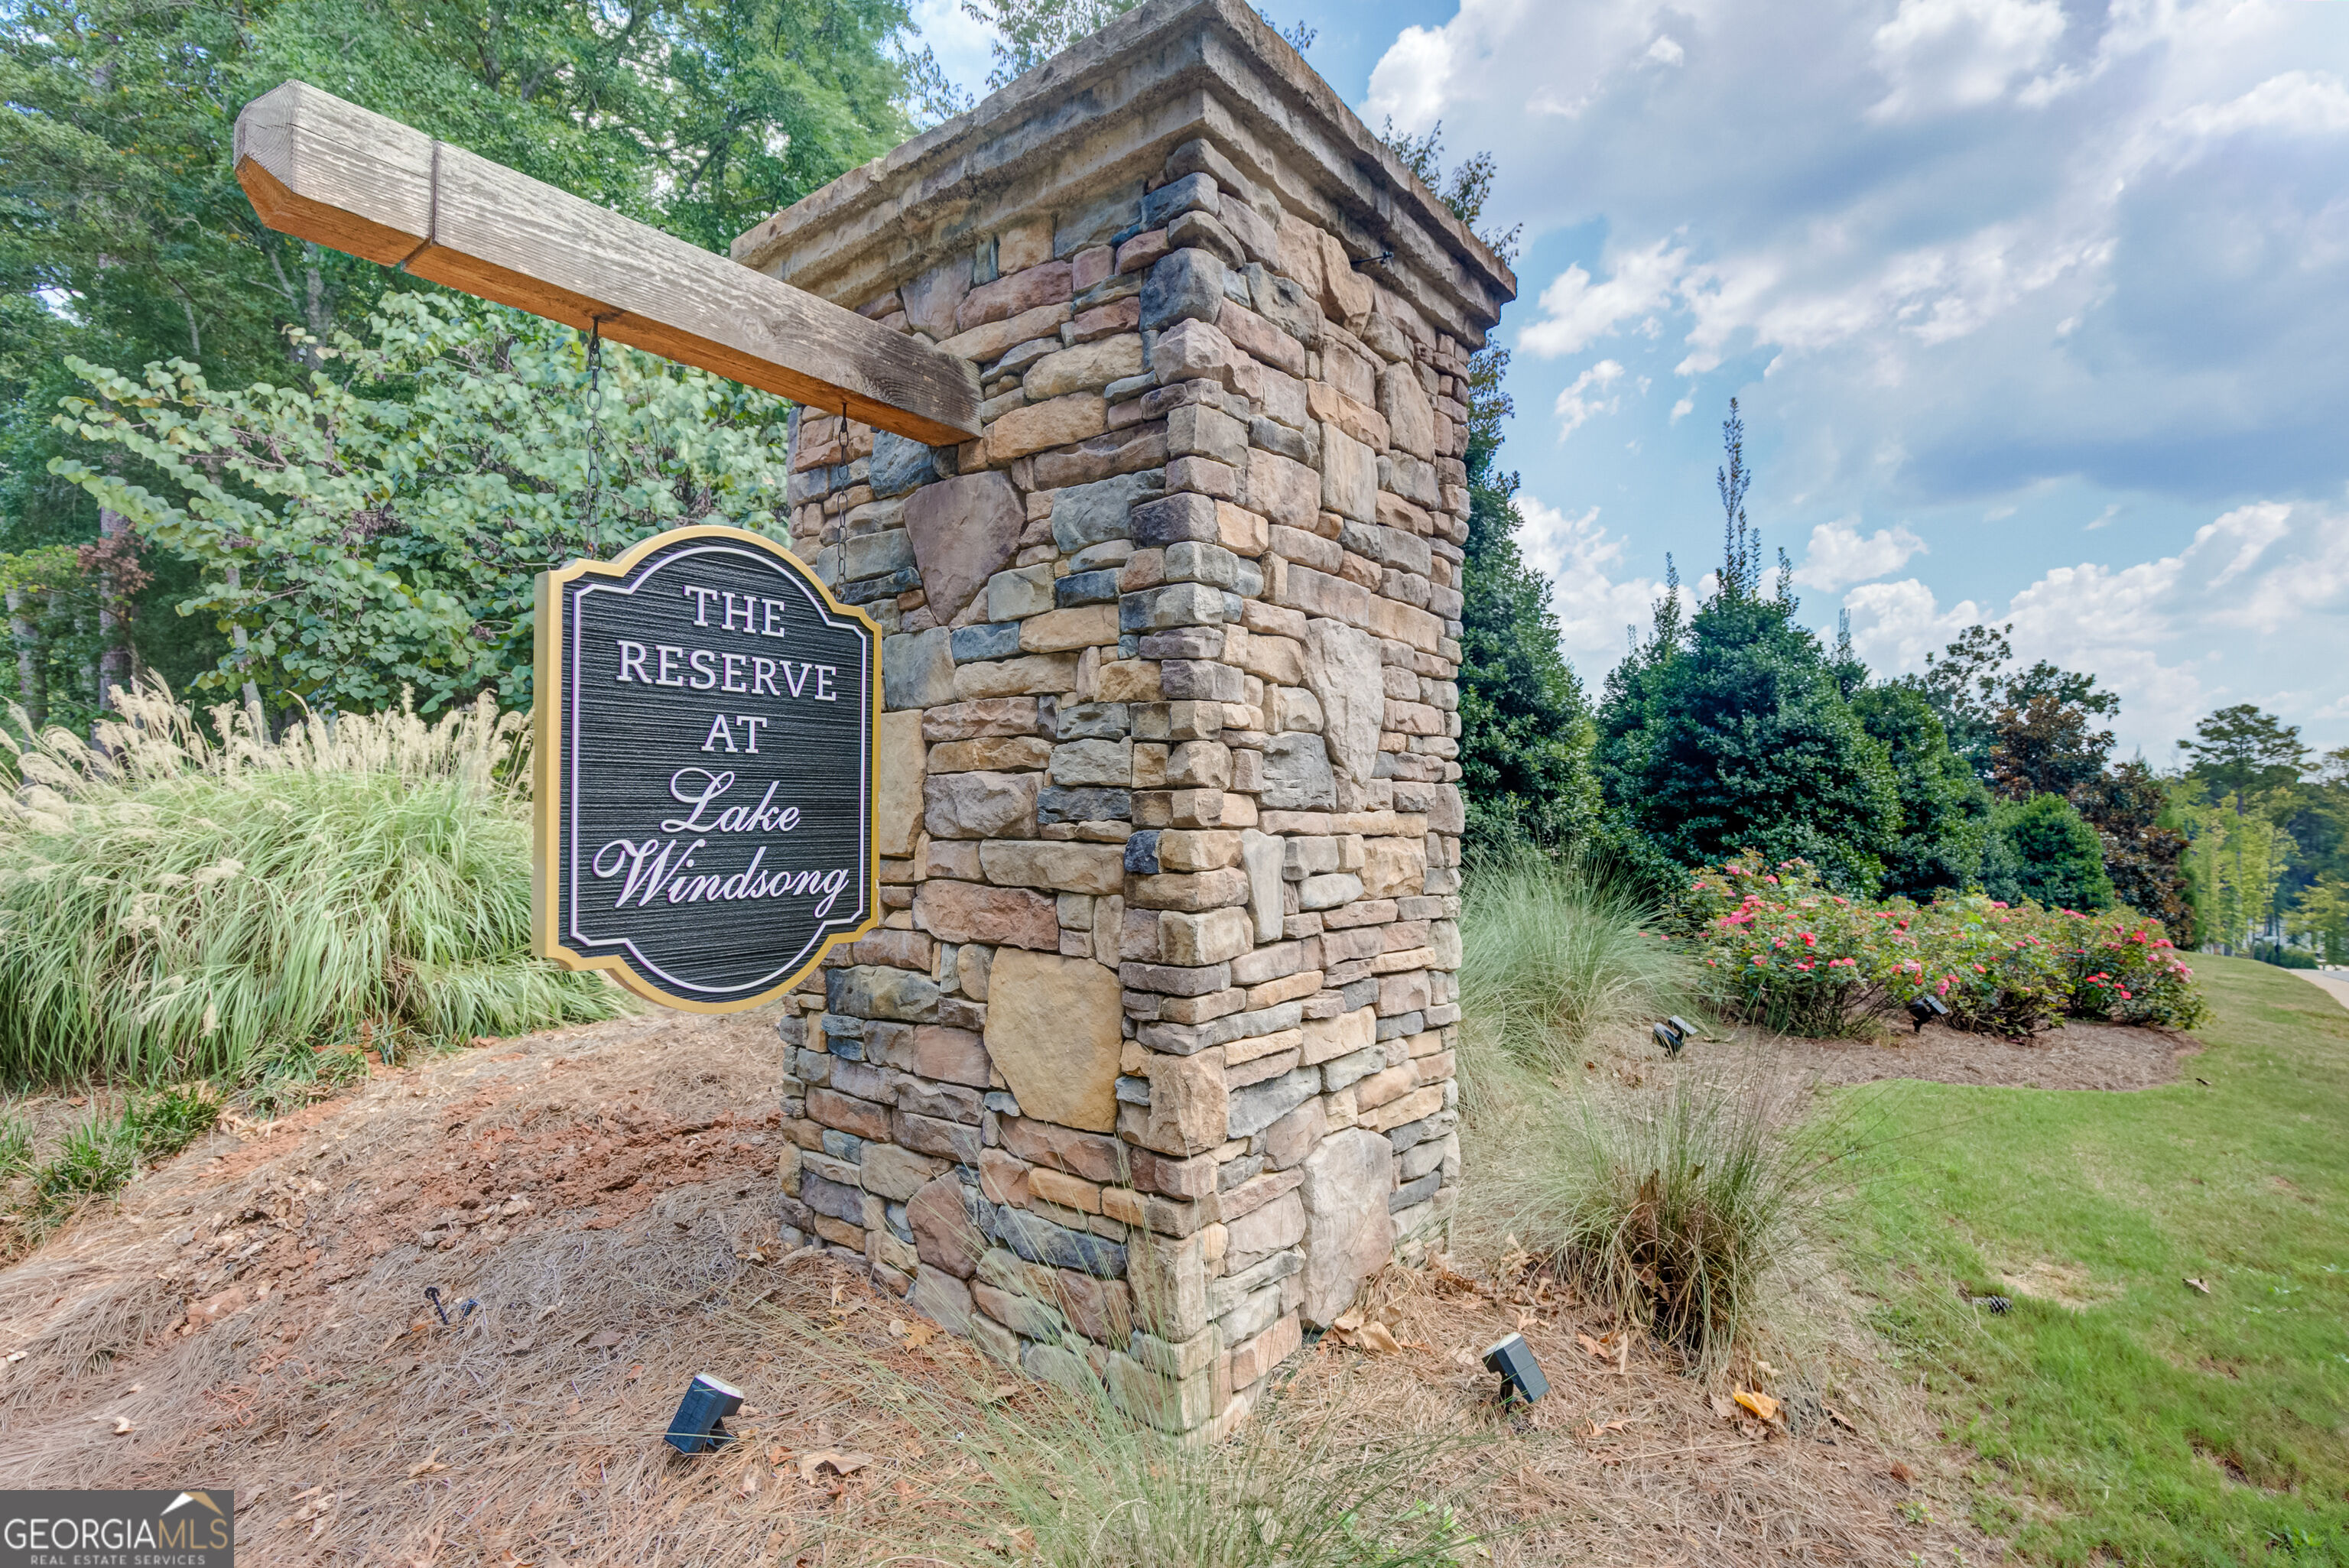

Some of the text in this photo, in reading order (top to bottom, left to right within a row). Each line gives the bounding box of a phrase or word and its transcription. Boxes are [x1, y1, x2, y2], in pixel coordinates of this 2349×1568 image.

[684, 585, 786, 638] THE
[616, 640, 837, 702] RESERVE
[700, 713, 768, 754] AT
[660, 767, 801, 835] Lake
[592, 838, 850, 919] Windsong
